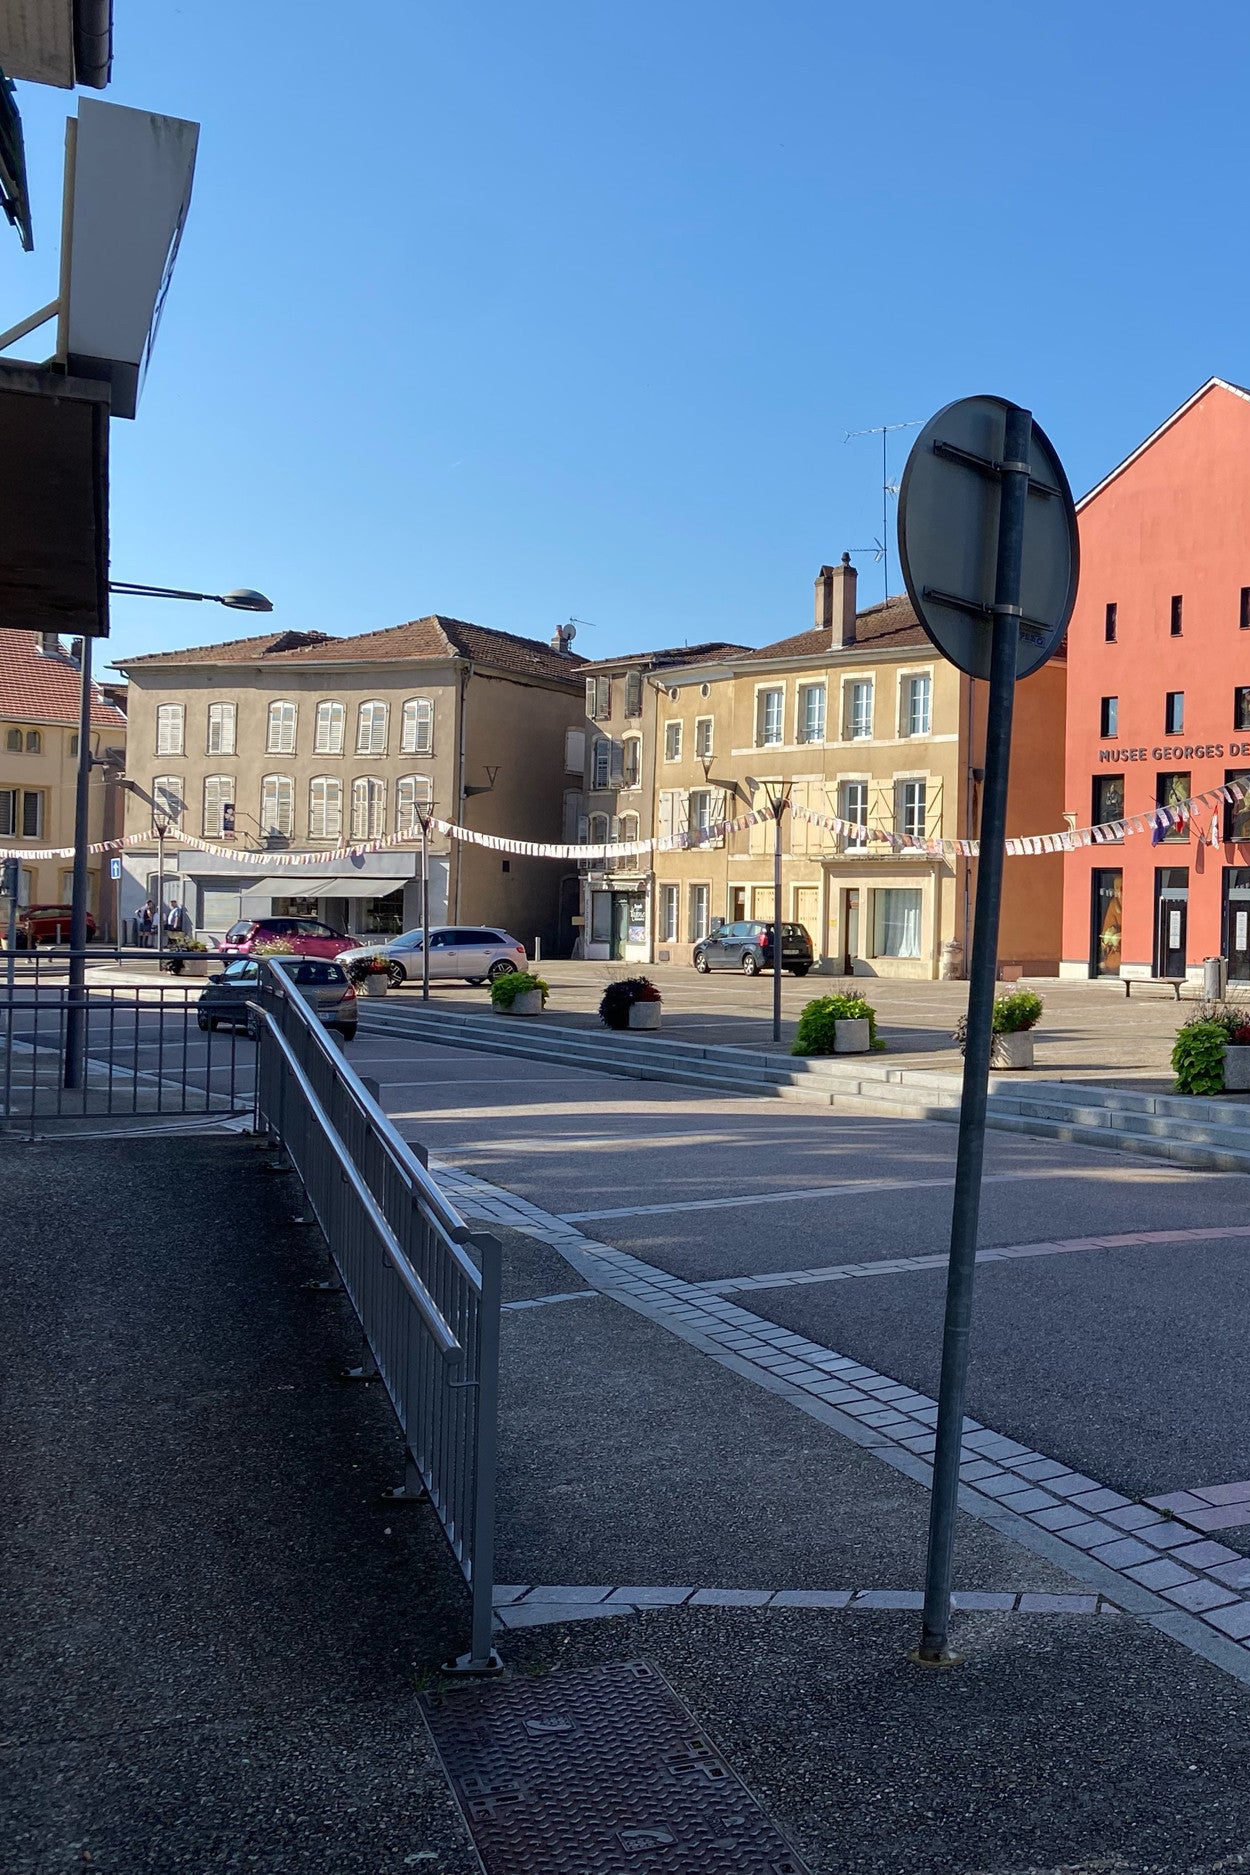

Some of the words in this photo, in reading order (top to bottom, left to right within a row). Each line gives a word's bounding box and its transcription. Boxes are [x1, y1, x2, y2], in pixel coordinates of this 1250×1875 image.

[1098, 747, 1148, 763] MUSEE
[1151, 743, 1224, 761] GEORGES
[1229, 742, 1250, 757] DE
